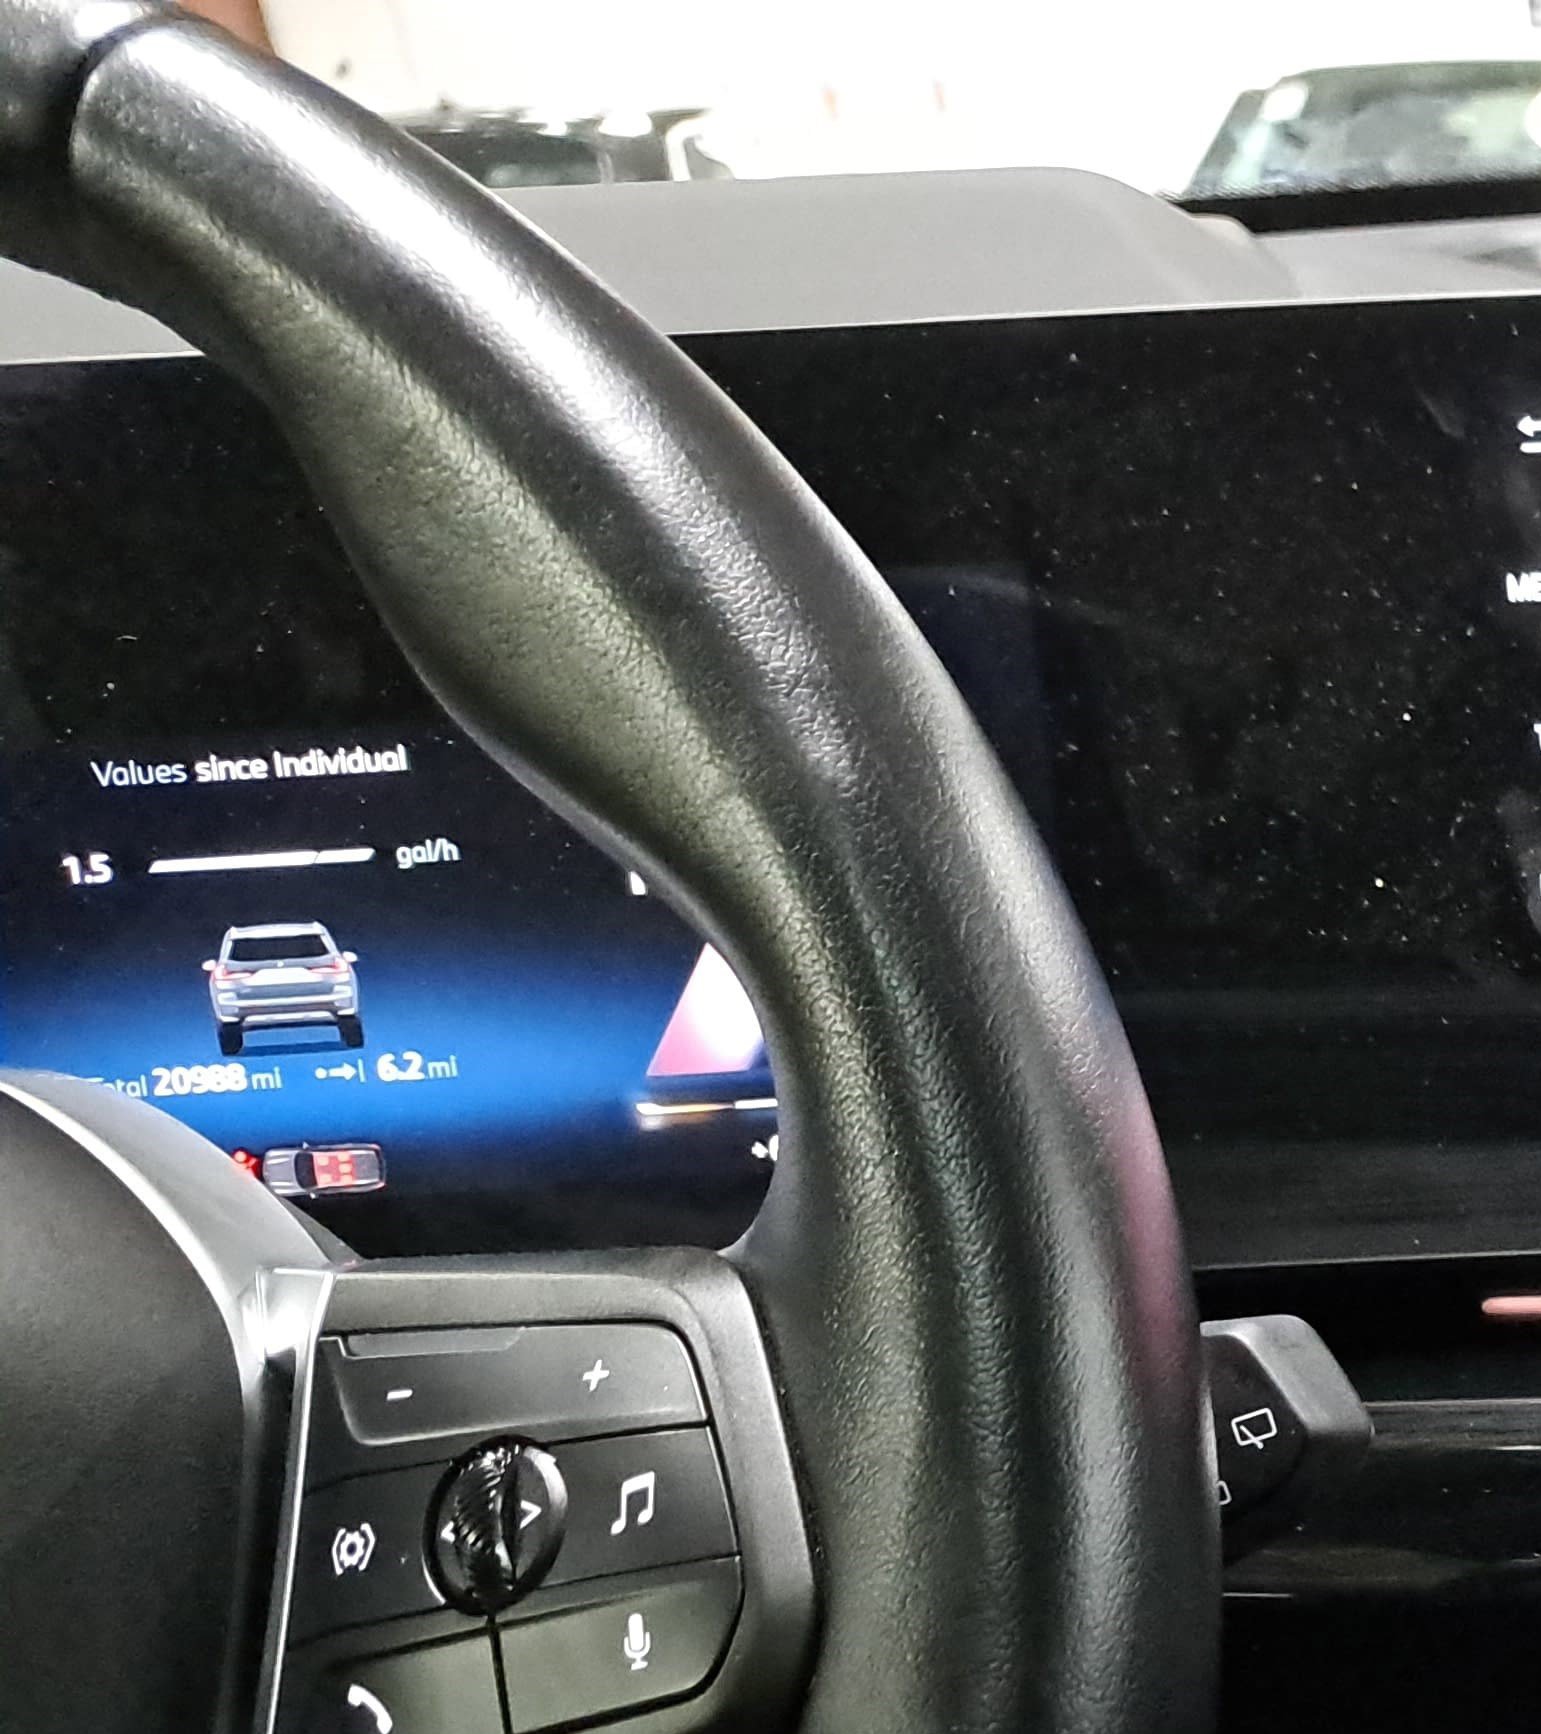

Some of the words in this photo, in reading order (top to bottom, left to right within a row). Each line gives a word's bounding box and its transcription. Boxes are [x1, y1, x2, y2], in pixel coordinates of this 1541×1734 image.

[90, 760, 188, 787] Values
[195, 754, 268, 782] since
[274, 744, 410, 778] Individual
[62, 852, 113, 885] 1.5
[396, 838, 460, 869] gal/h
[87, 1074, 148, 1098] tal
[252, 1067, 282, 1090] mi
[376, 1051, 425, 1082] 6.2
[428, 1055, 458, 1078] mi
